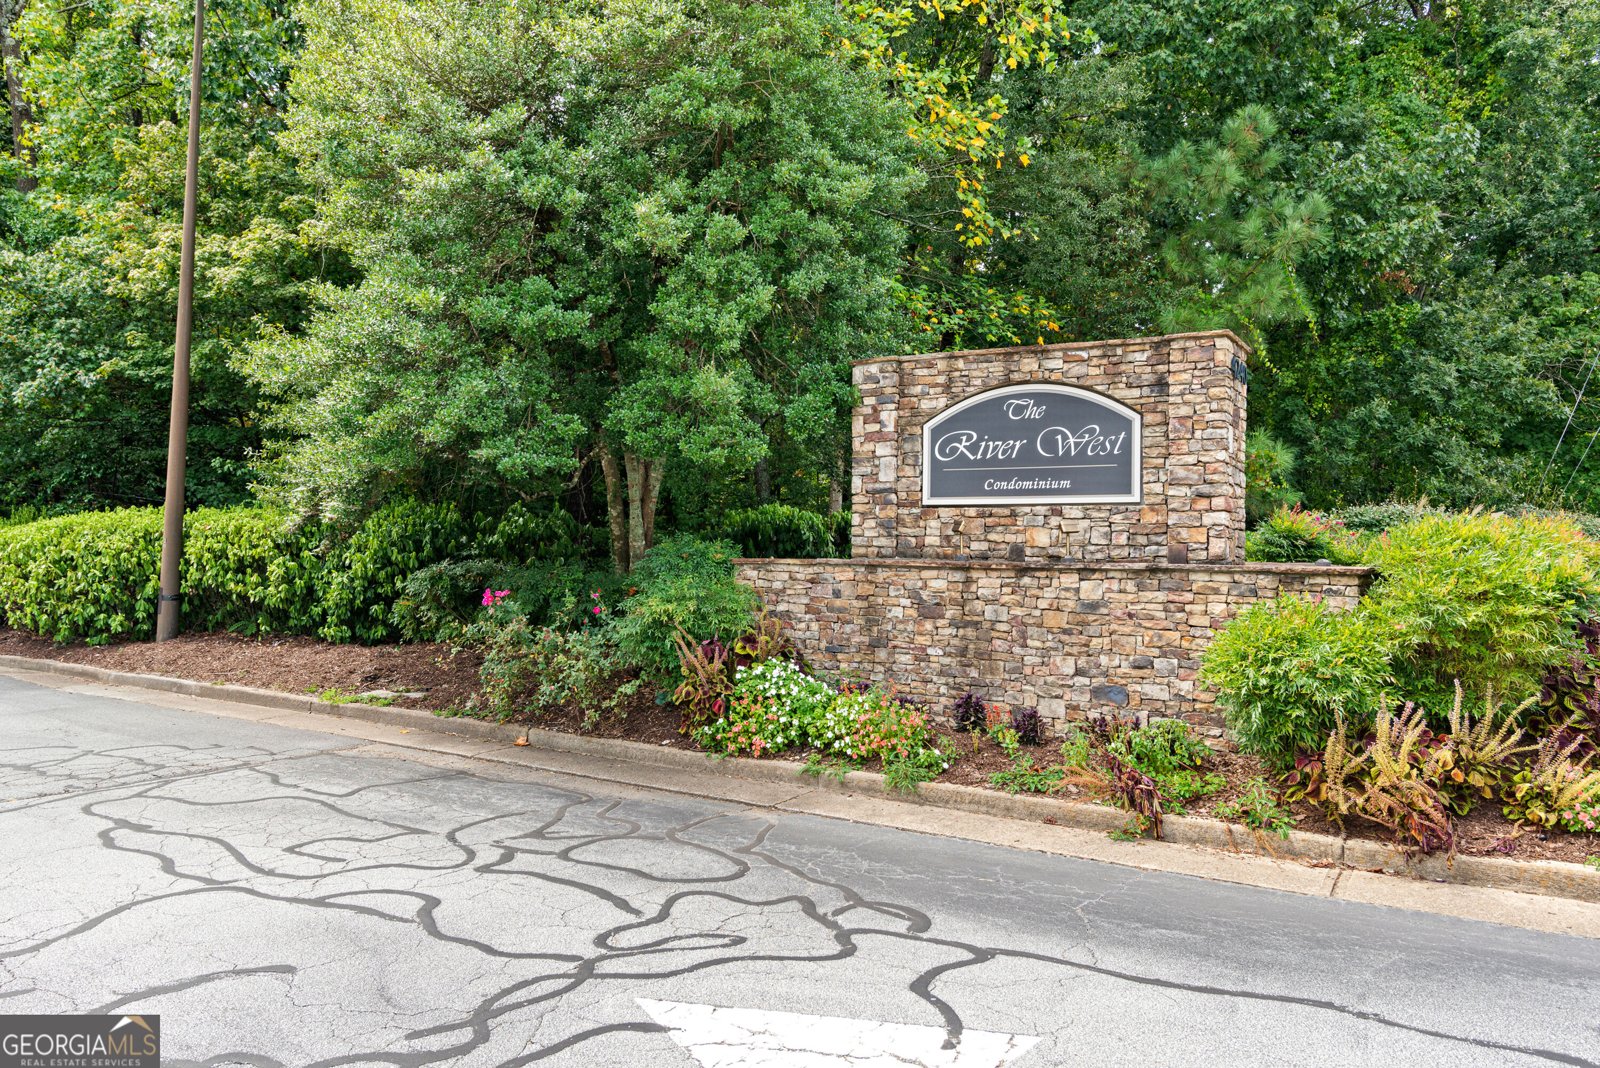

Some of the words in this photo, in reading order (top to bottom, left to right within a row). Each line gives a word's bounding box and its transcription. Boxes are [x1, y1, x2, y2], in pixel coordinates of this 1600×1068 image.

[1004, 399, 1046, 420] The
[934, 430, 1027, 462] River
[1036, 424, 1127, 457] West
[984, 477, 1072, 490] Condominium
